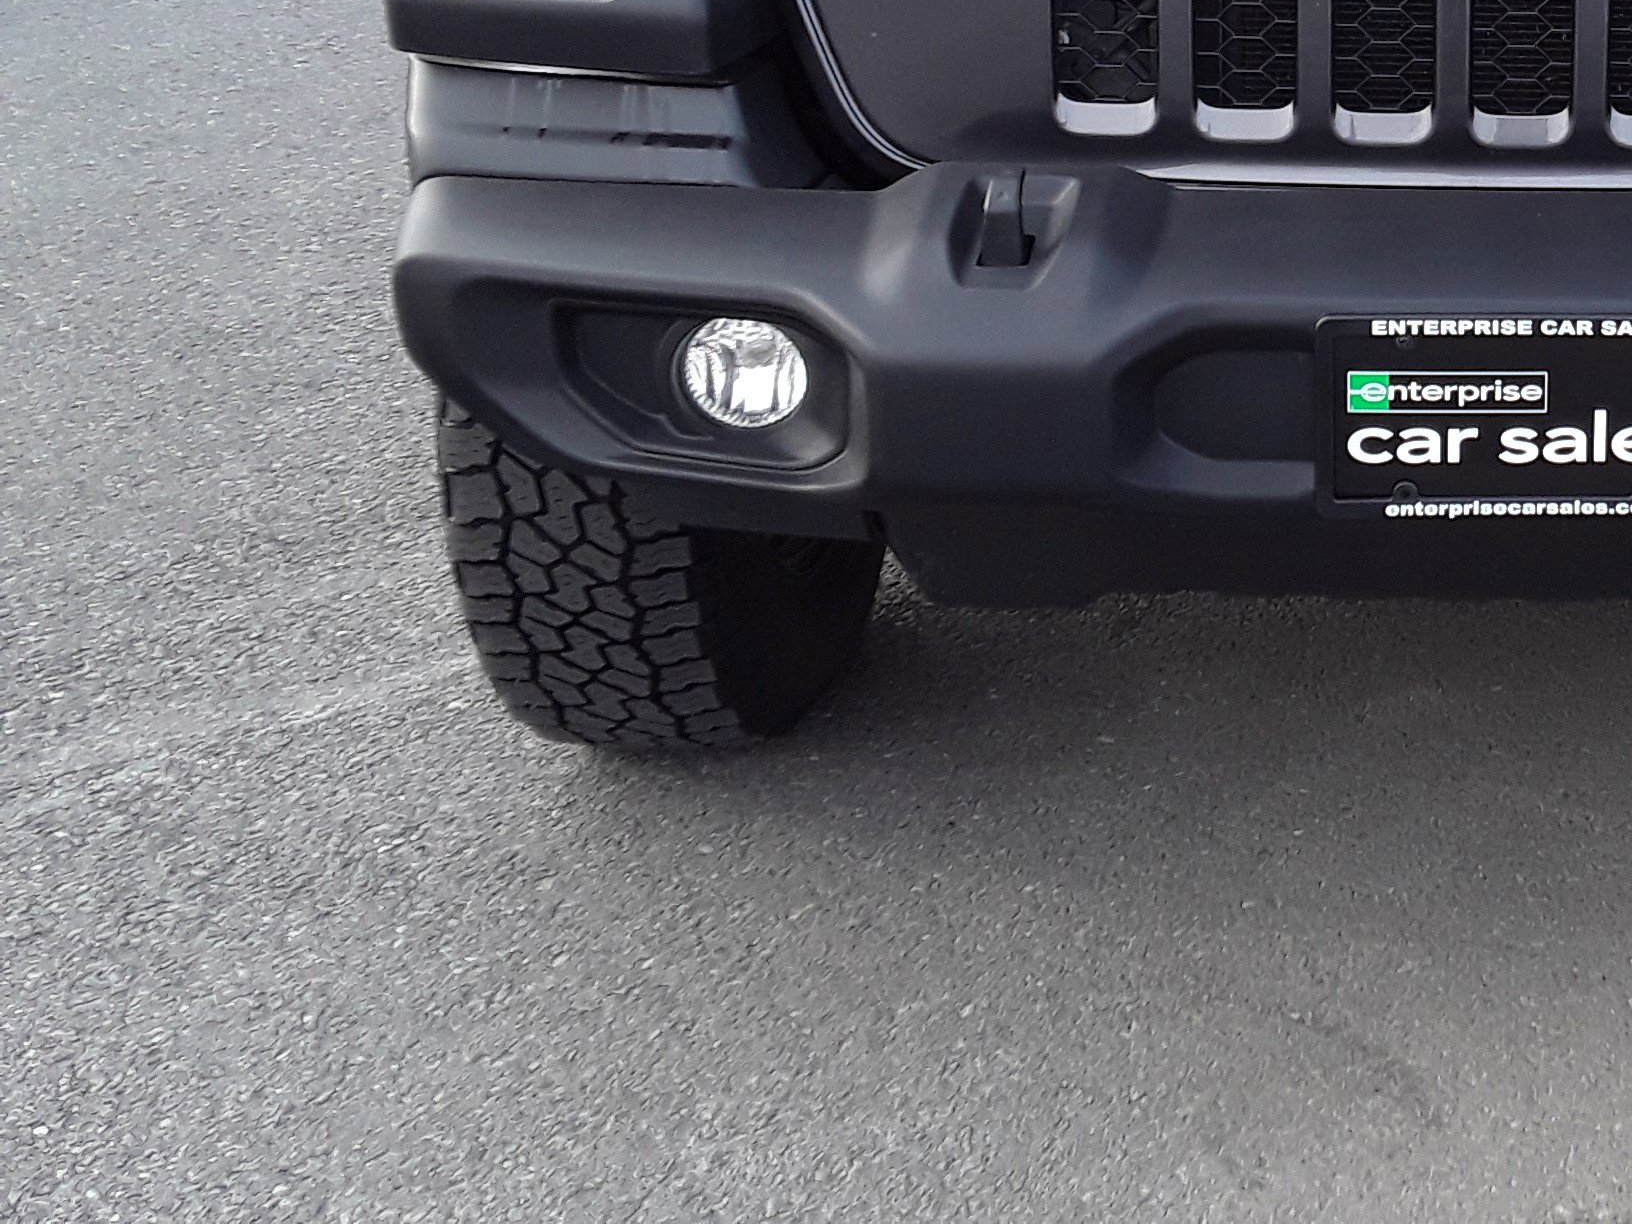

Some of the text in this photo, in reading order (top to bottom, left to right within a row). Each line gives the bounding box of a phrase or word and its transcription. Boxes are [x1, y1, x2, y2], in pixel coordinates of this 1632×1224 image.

[1371, 319, 1533, 337] ENTERPRISE
[1540, 320, 1594, 337] CAR
[1361, 380, 1543, 407] enterprise
[1347, 424, 1479, 465] car
